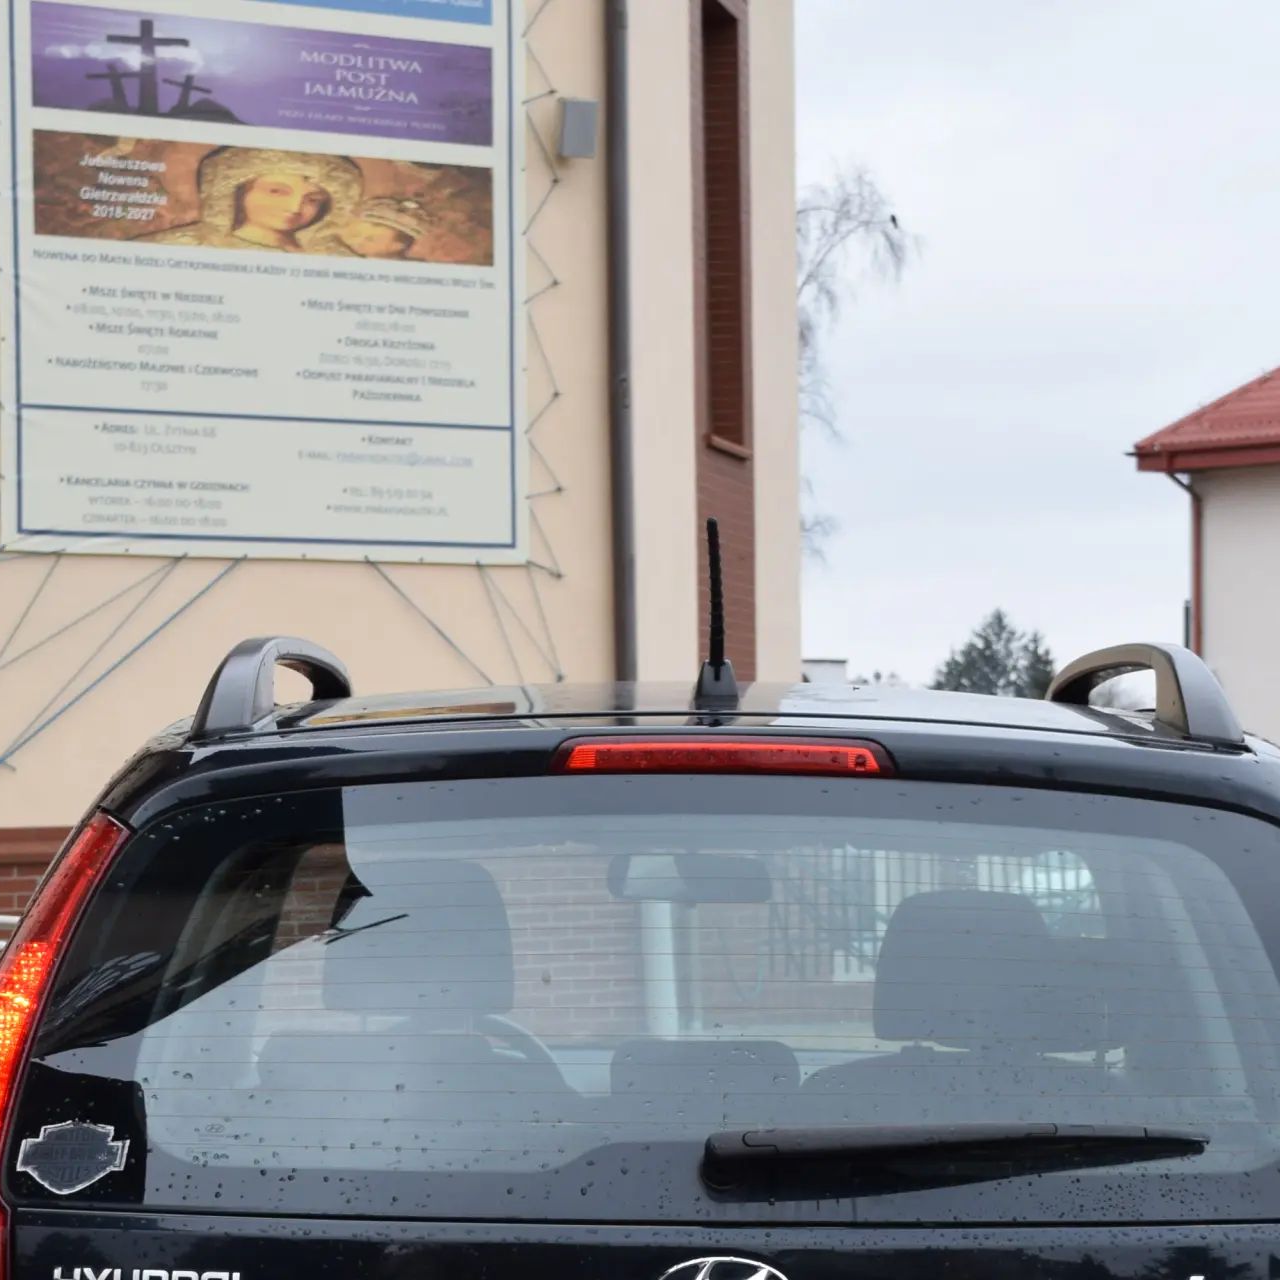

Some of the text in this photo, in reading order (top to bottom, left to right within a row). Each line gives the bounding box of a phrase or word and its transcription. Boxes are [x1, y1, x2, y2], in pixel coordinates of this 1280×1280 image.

[300, 50, 422, 74] MODLITWA
[335, 68, 389, 86] POST
[79, 154, 167, 172] Jubileuszowa
[97, 171, 149, 188] Nowena
